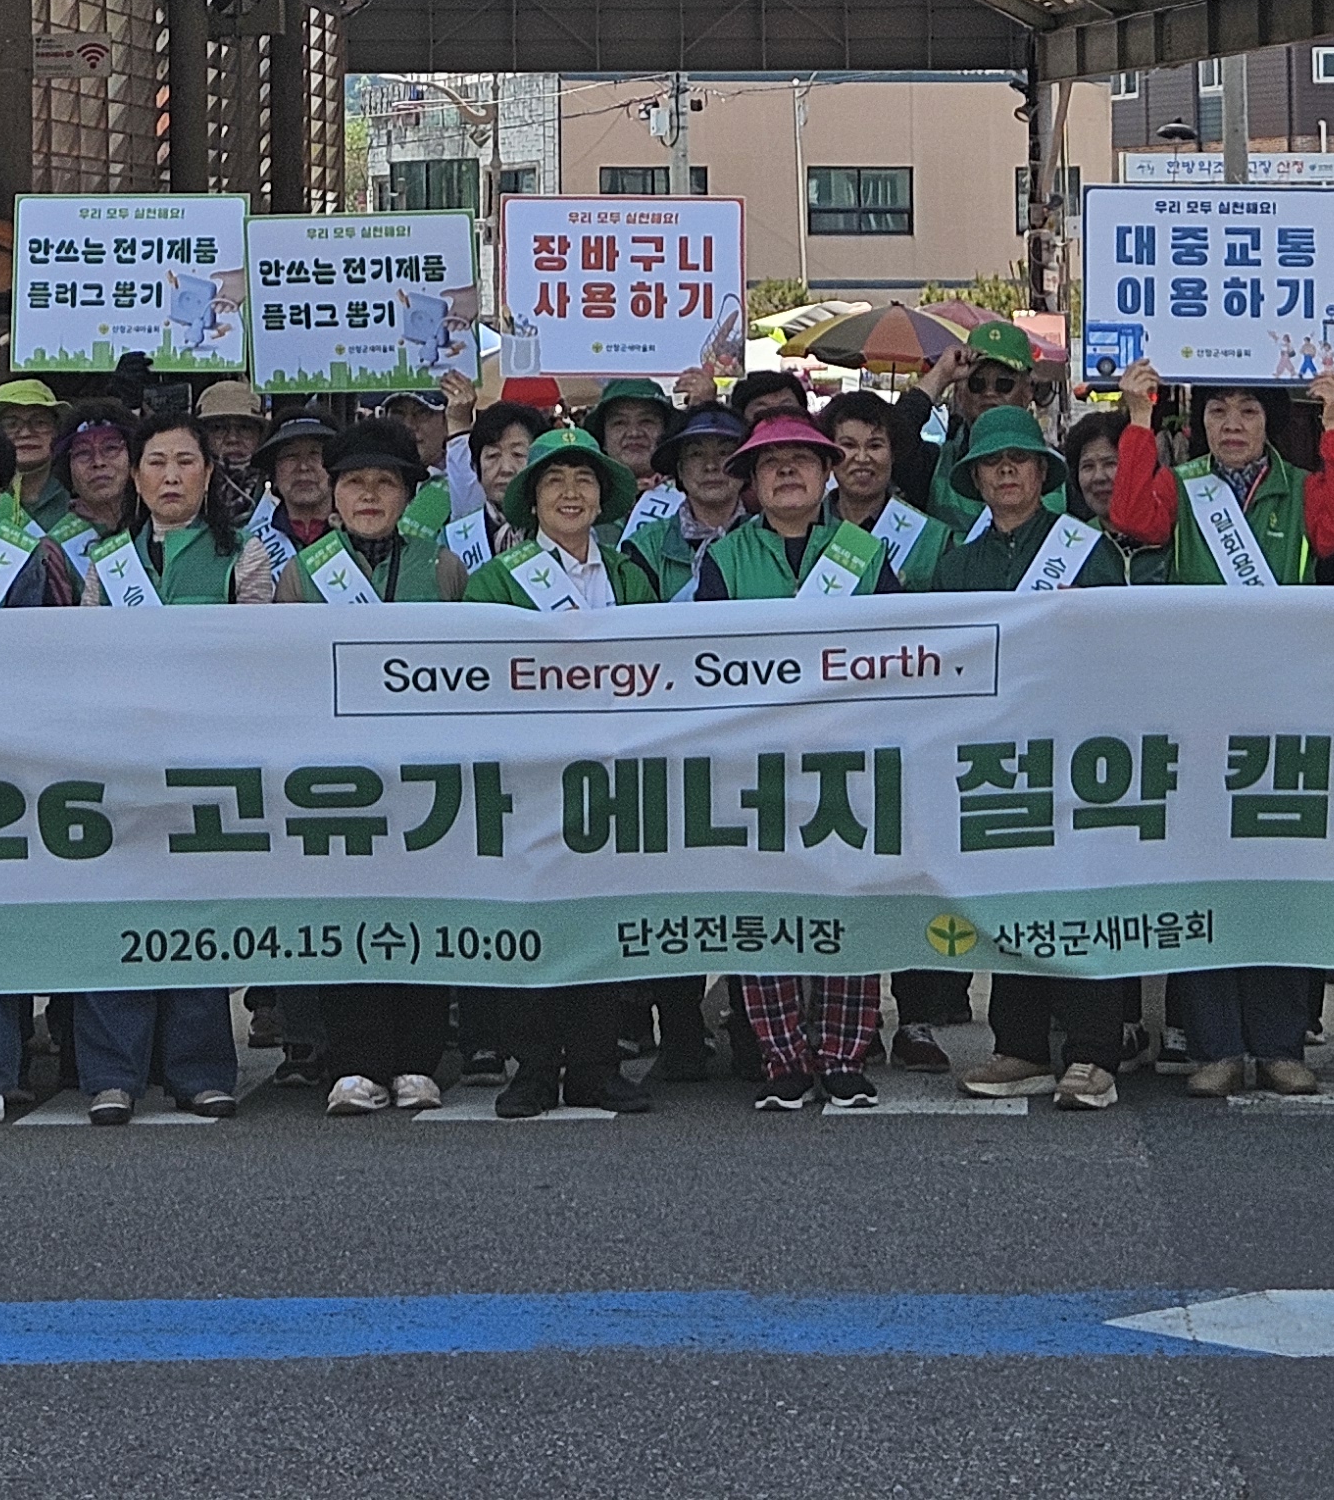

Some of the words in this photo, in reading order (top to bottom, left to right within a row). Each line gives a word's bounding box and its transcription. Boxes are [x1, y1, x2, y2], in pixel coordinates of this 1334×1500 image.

[1154, 200, 1182, 214] 우리
[1186, 200, 1213, 214] 모두
[1218, 200, 1277, 216] 실천해요!
[28, 236, 107, 265] 안쓰는
[113, 236, 219, 265] 전기제품
[532, 234, 714, 273] 장바구니
[1115, 224, 1316, 268] 대중교통
[258, 257, 337, 287] 안쓰는
[342, 254, 447, 285] 전기제품
[27, 281, 106, 309] 플러그
[112, 280, 163, 309] 뽑기
[532, 281, 714, 320] 사용하기
[1116, 276, 1315, 319] 이용하기
[261, 301, 340, 331] 플러그
[345, 300, 396, 329] 뽑기
[382, 655, 492, 693] Save
[693, 650, 803, 689] Save
[164, 760, 515, 858] 고유가
[560, 746, 904, 856] 에너지
[954, 732, 1179, 853] 절약
[120, 925, 345, 966] 2026.04.15
[355, 920, 423, 966] (수)
[433, 925, 543, 964] 10:00
[616, 914, 846, 958] 단성전통시장
[992, 909, 1216, 960] 산청군새마을회
